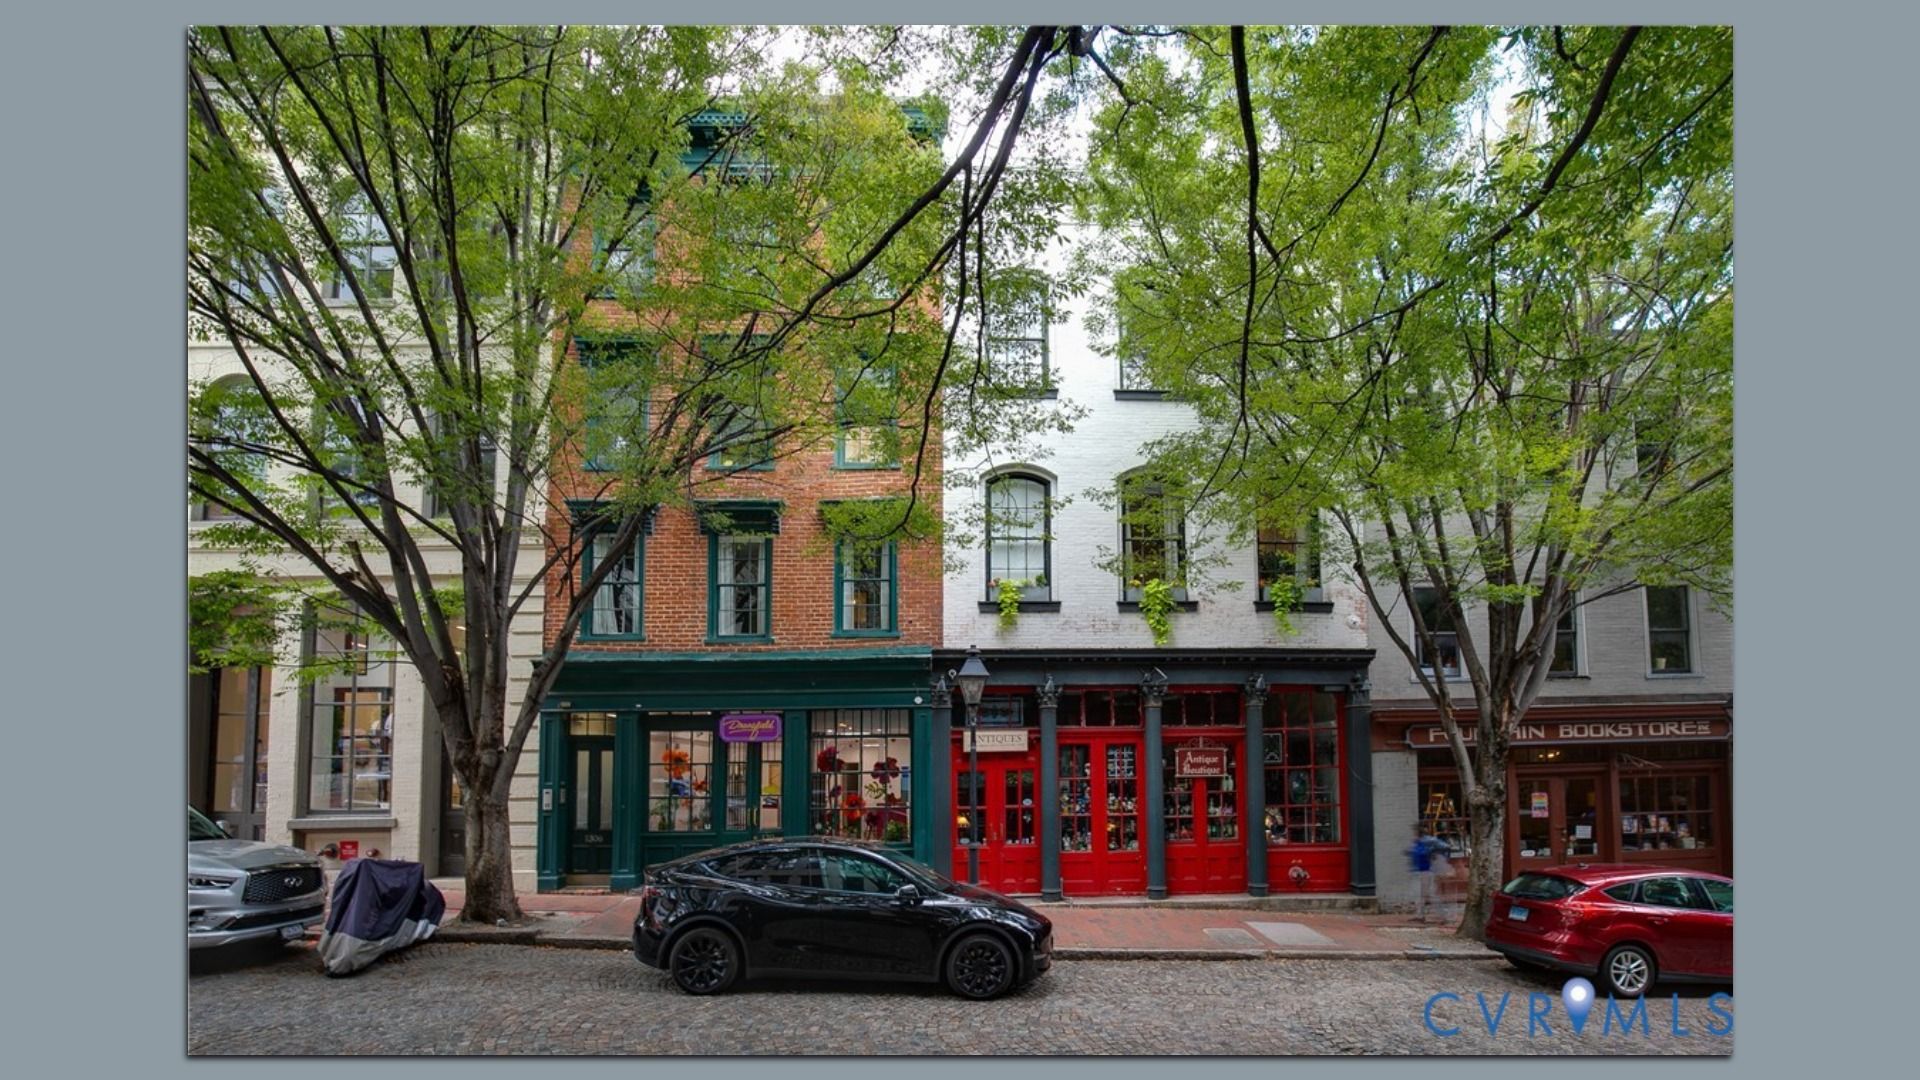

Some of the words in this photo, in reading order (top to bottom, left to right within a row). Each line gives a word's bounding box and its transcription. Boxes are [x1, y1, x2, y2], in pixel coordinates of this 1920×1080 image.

[1559, 721, 1697, 738] BOOKSTORE
[976, 734, 1023, 745] NTIQUES
[1183, 751, 1219, 765] Antique
